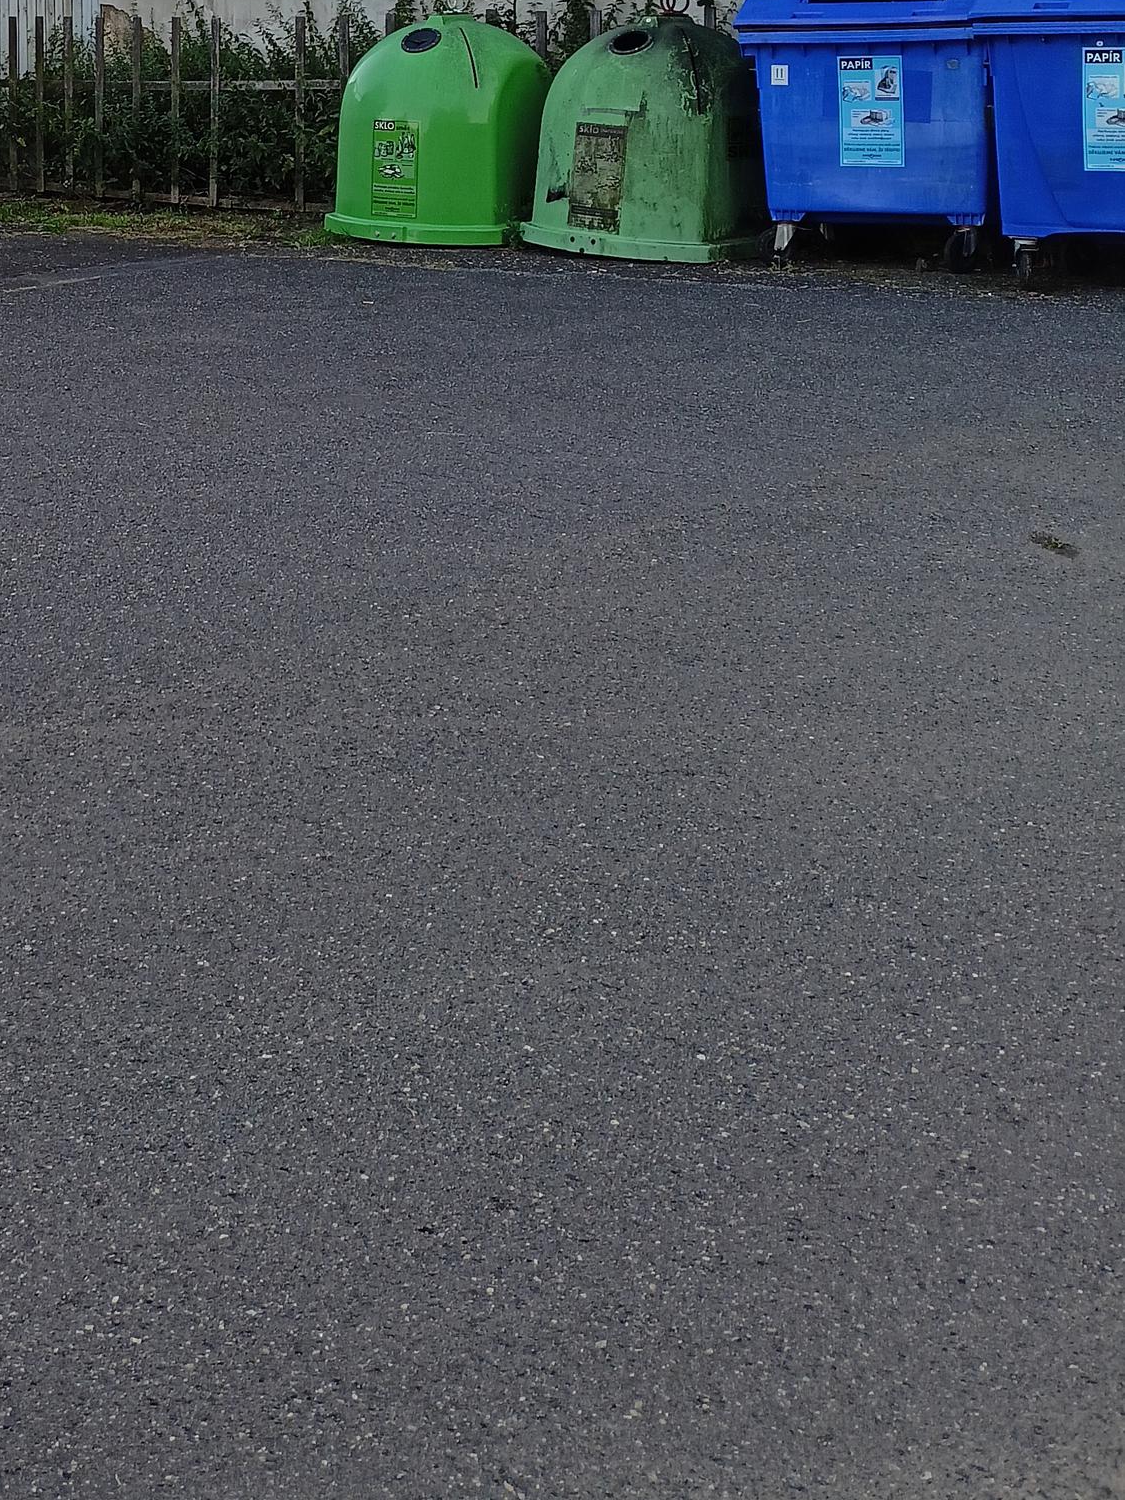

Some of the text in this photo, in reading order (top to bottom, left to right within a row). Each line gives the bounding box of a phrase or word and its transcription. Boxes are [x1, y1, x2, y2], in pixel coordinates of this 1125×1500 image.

[1086, 51, 1121, 63] PAPÍR
[841, 58, 871, 69] PAPÍR
[374, 121, 395, 130] SKLO
